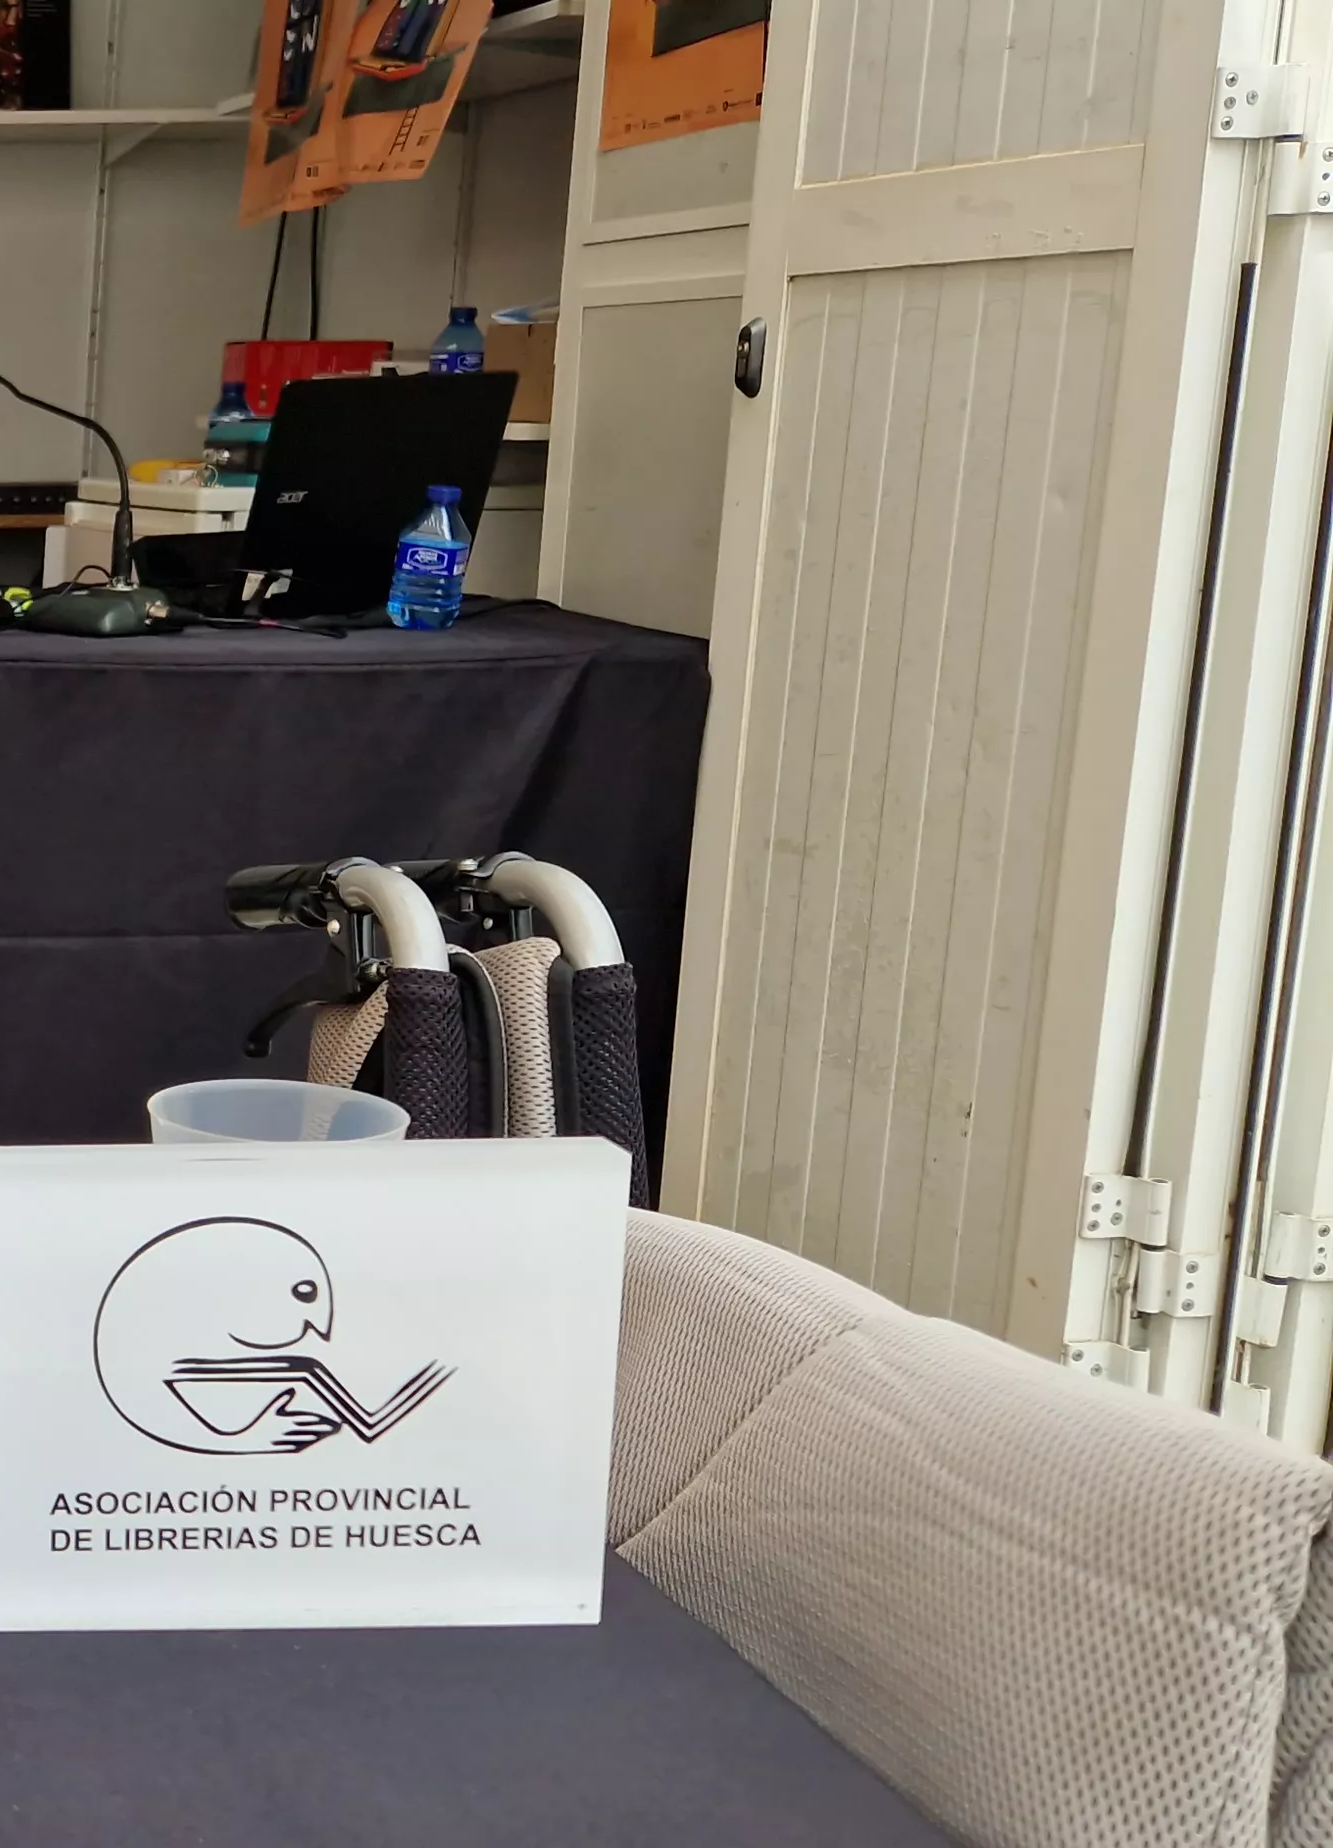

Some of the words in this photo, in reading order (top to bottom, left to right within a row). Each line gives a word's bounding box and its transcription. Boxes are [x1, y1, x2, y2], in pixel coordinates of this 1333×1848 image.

[276, 490, 309, 504] acer
[49, 1484, 258, 1516] ASOCIACIÓN
[270, 1487, 471, 1513] PROVINCIAL
[50, 1528, 93, 1552] DE
[104, 1526, 279, 1551] LIBRERIAS
[290, 1525, 334, 1549] DE
[344, 1523, 482, 1548] HUESCA
